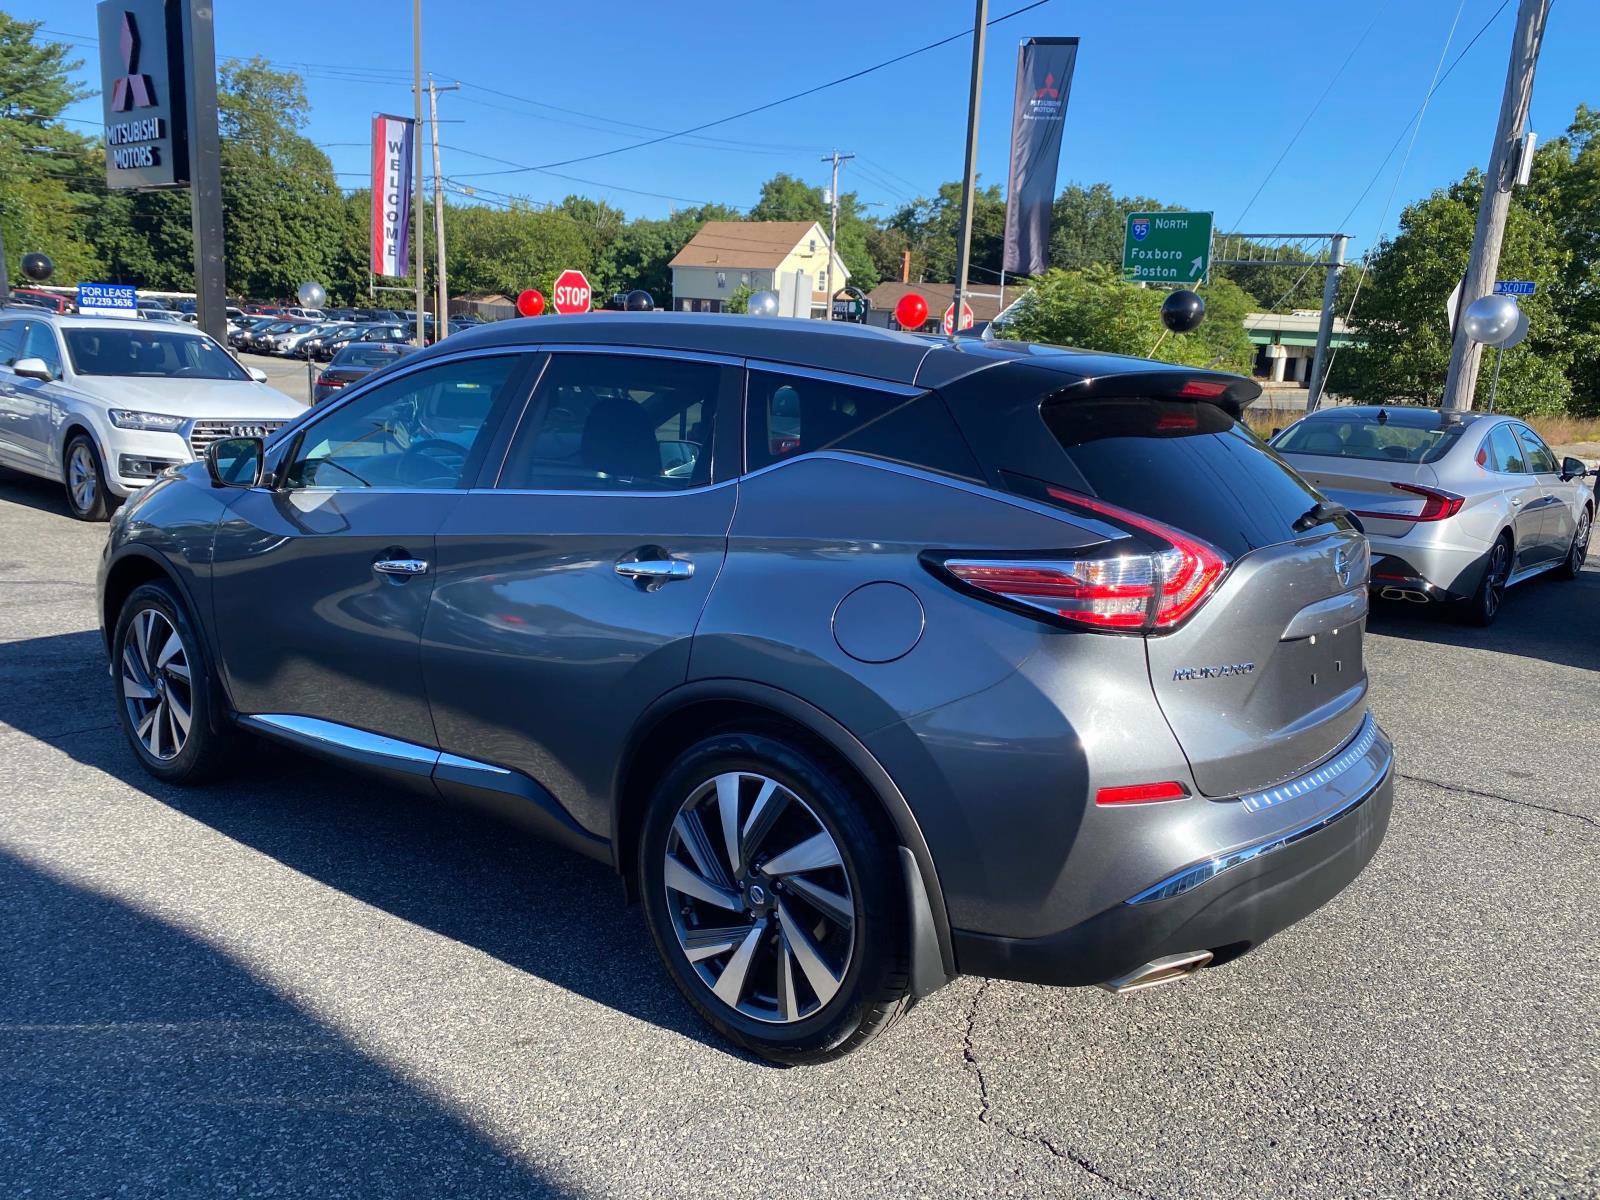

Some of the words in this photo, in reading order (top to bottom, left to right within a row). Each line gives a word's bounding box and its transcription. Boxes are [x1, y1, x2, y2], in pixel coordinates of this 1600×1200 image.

[106, 118, 159, 145] MITSUBISHI
[114, 146, 153, 169] MOTORS
[386, 141, 403, 257] WELCOME
[1134, 224, 1147, 235] 95
[1155, 219, 1188, 229] NORTH
[1131, 248, 1183, 260] Foxboro
[1134, 265, 1177, 277] Boston
[81, 286, 102, 297] FOR
[103, 288, 134, 298] LEASE
[1503, 283, 1528, 293] SCOTT
[557, 286, 588, 307] STOP
[947, 314, 972, 329] SP
[1173, 662, 1255, 681] MURANO
